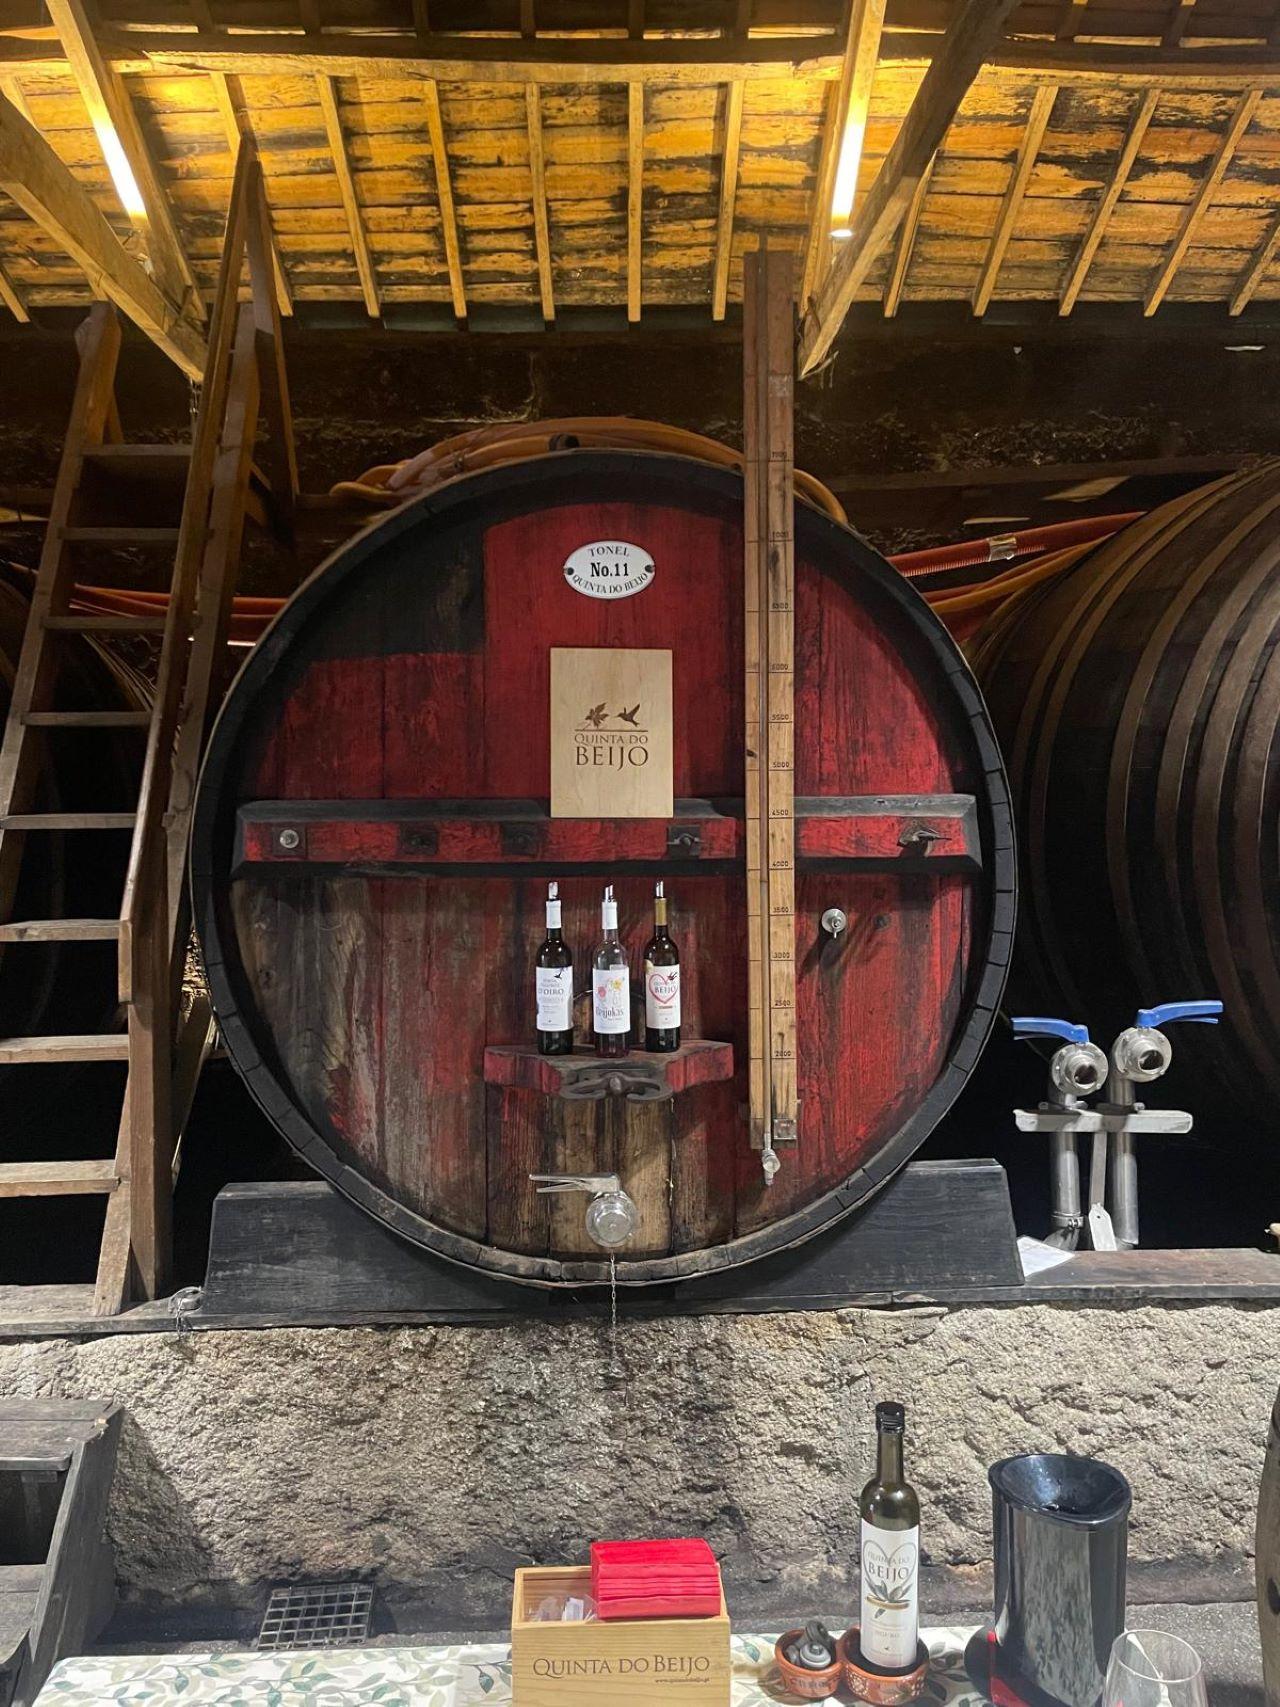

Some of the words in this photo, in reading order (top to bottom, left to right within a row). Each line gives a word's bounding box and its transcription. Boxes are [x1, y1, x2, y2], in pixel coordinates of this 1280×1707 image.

[588, 545, 630, 557] TONEL
[590, 562, 629, 577] No.11
[572, 574, 607, 594] QUINTA
[609, 585, 622, 593] DO
[625, 573, 648, 592] BEIJO
[574, 733, 625, 746] QUINTA
[629, 734, 648, 744] DO
[576, 745, 649, 771] BEIJO
[868, 1561, 909, 1583] BEIJO
[533, 1658, 611, 1678] QUINTA
[619, 1658, 649, 1674] DO
[653, 1655, 710, 1676] BEIJO
